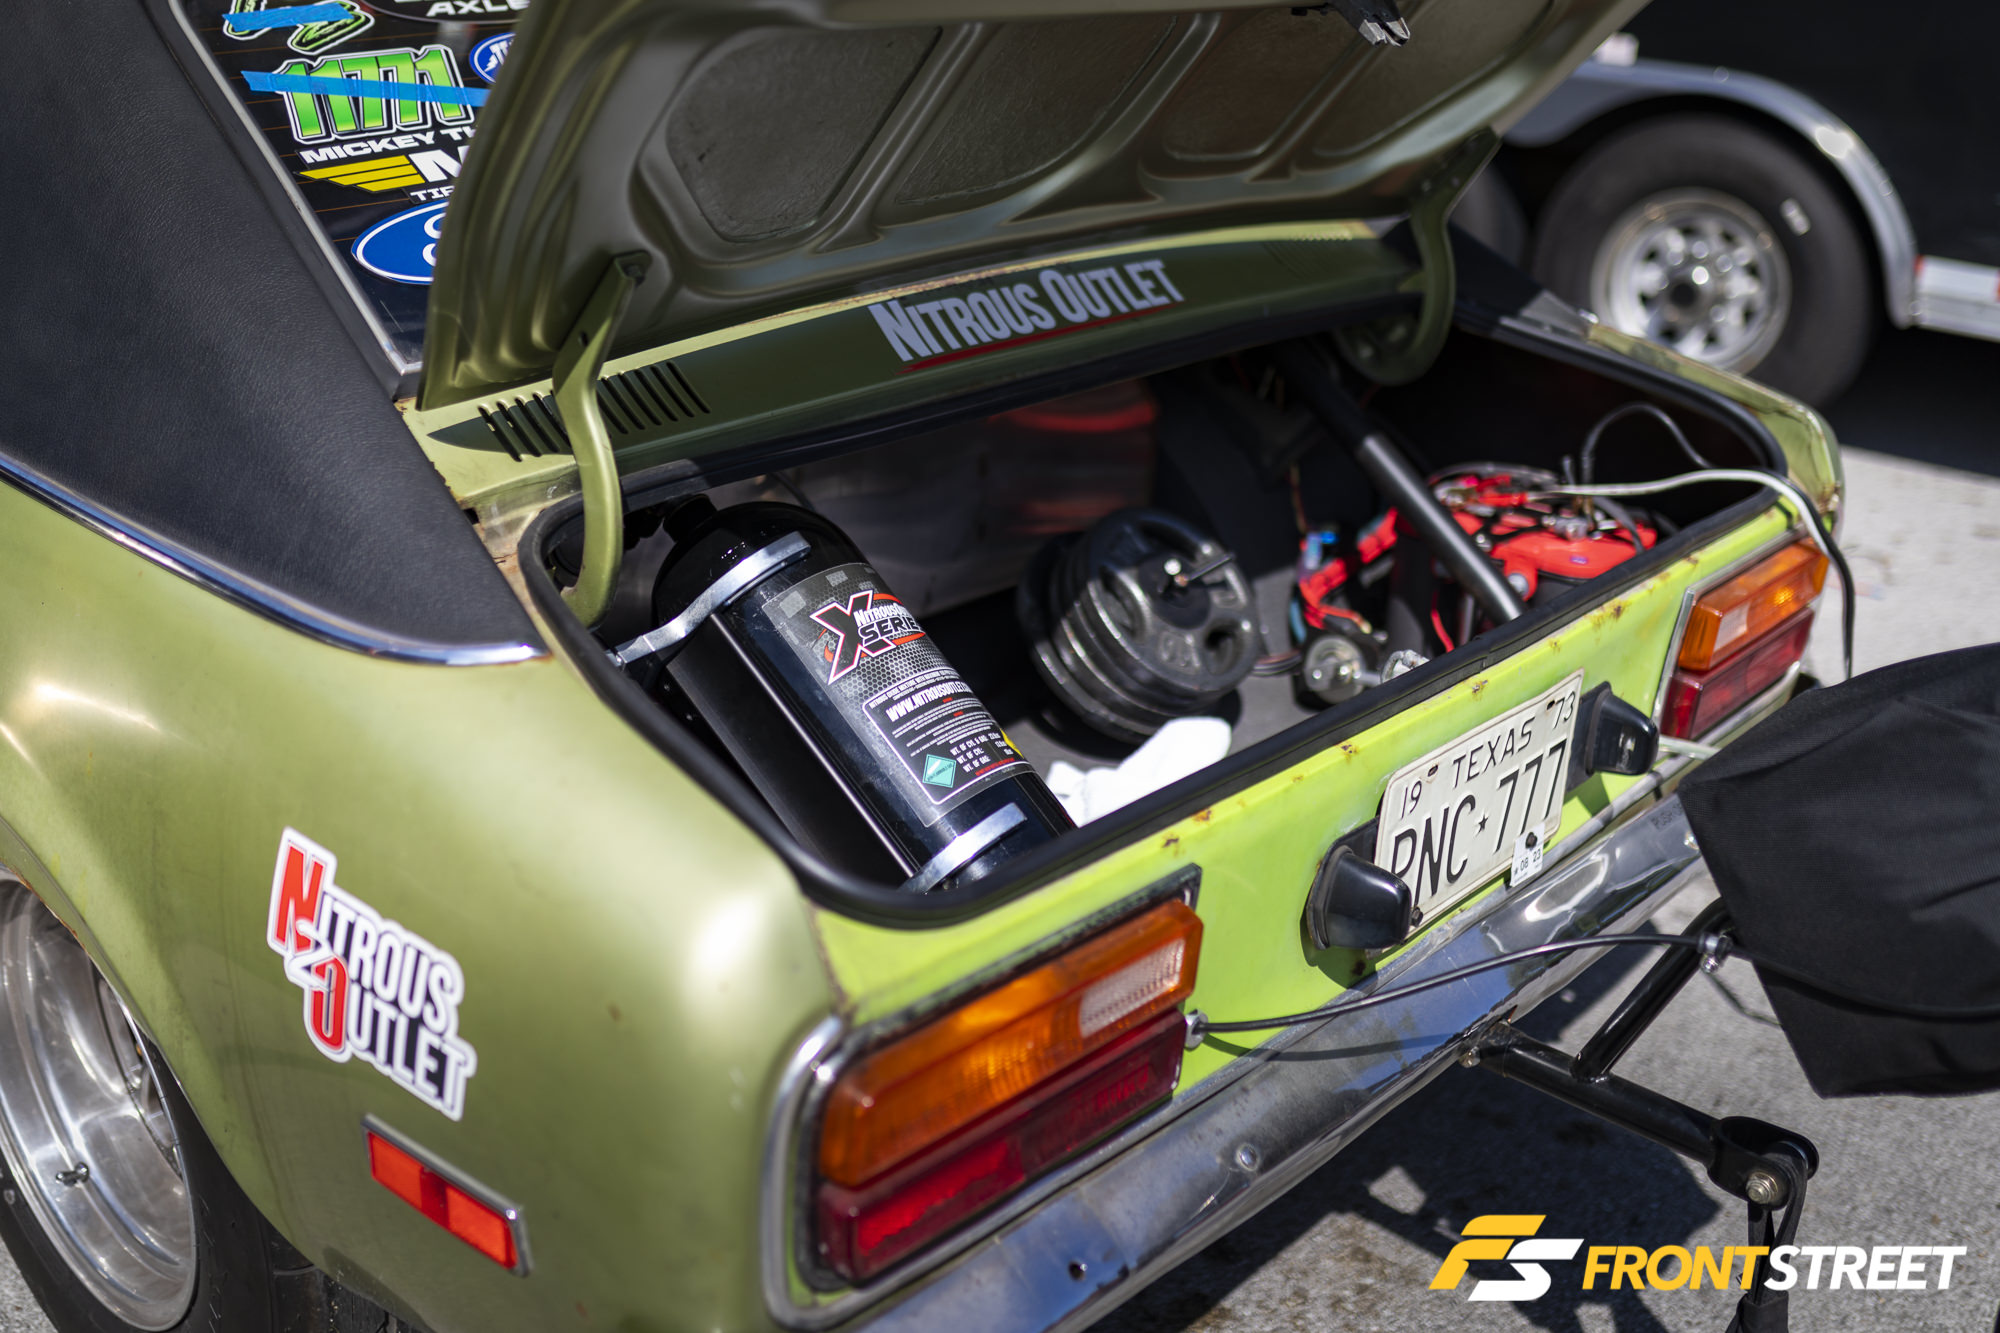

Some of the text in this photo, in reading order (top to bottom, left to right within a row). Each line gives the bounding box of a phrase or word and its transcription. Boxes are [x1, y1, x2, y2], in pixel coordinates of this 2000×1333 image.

[299, 130, 435, 164] MICKEY
[867, 259, 1185, 362] NITROUS OUTLET
[1401, 691, 1576, 819] 19 TEXAS 73
[1493, 738, 1567, 854] 777
[1520, 857, 1529, 871] 08
[1533, 848, 1541, 863] 23
[270, 838, 458, 1037] NITROUS
[309, 955, 469, 1115] OUTLET
